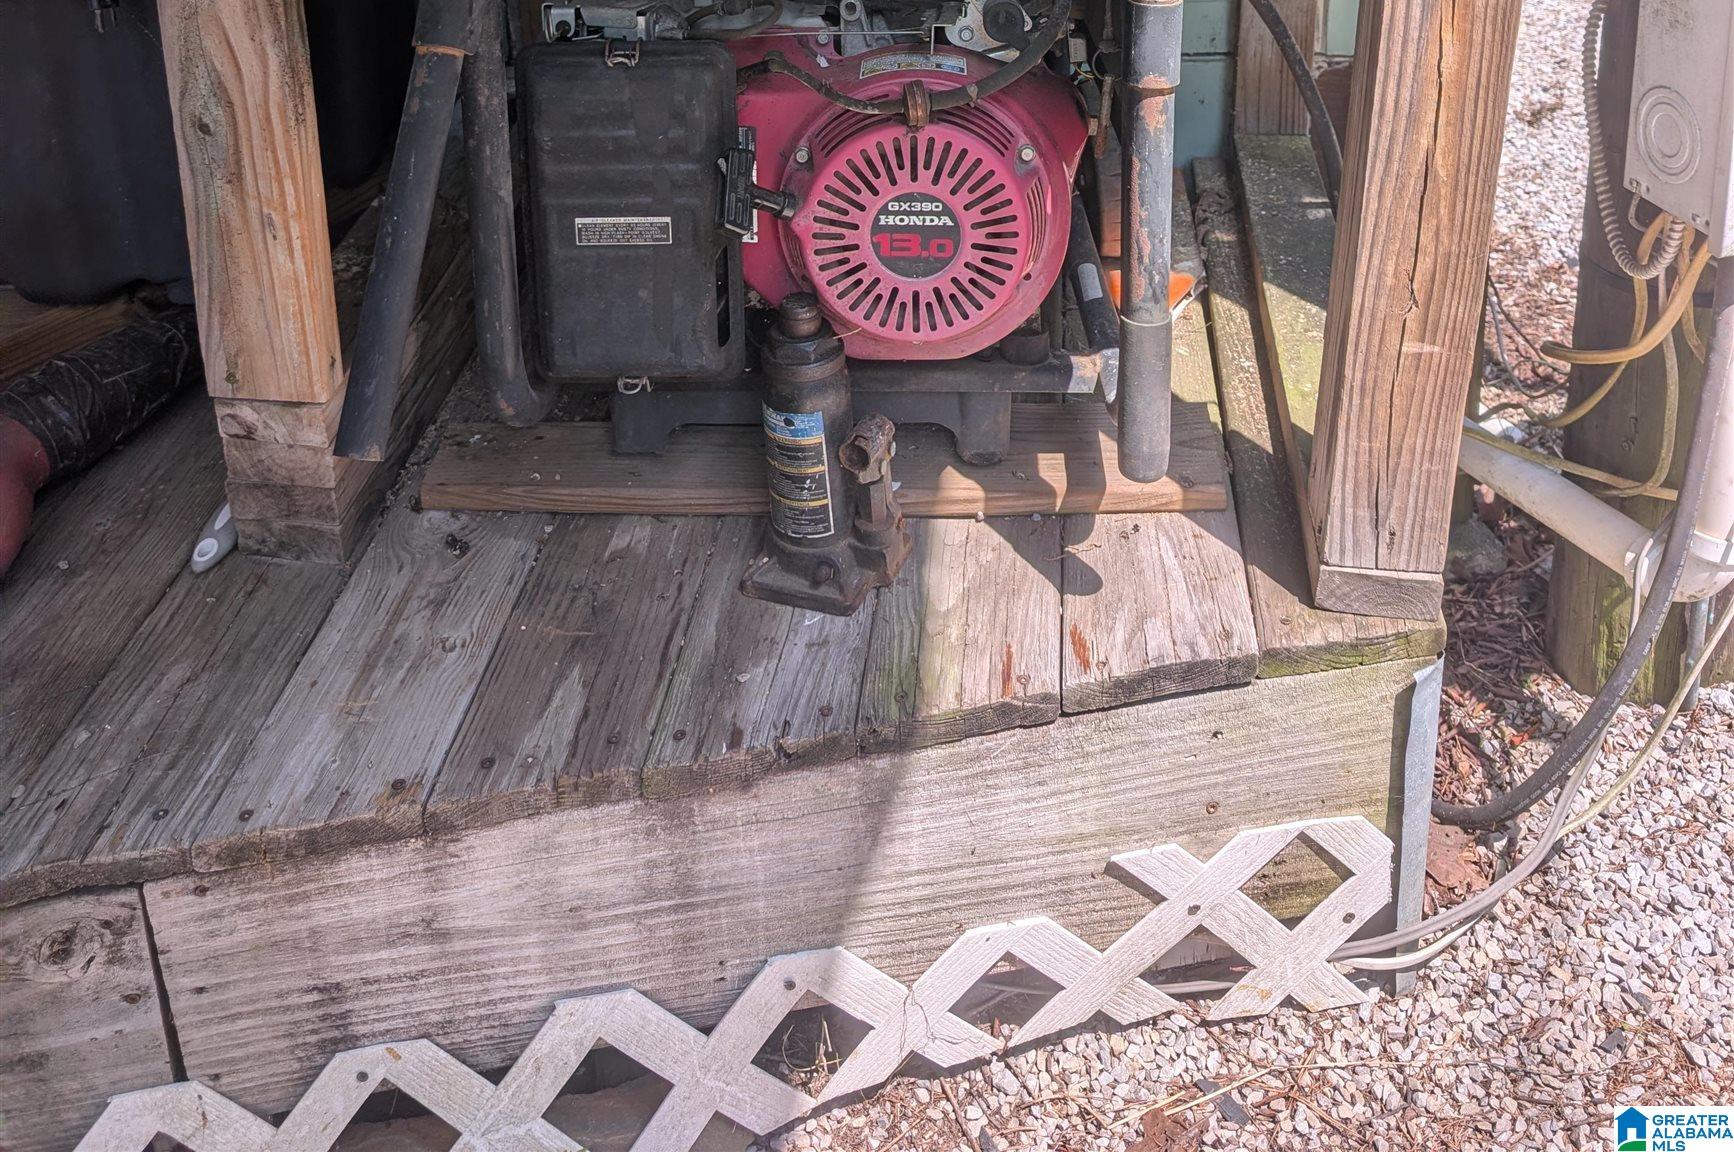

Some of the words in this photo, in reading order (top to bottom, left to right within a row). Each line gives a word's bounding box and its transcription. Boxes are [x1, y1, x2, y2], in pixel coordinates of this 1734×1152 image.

[888, 202, 942, 211] GX390
[879, 215, 954, 226] HONDA
[873, 233, 954, 258] 13.0
